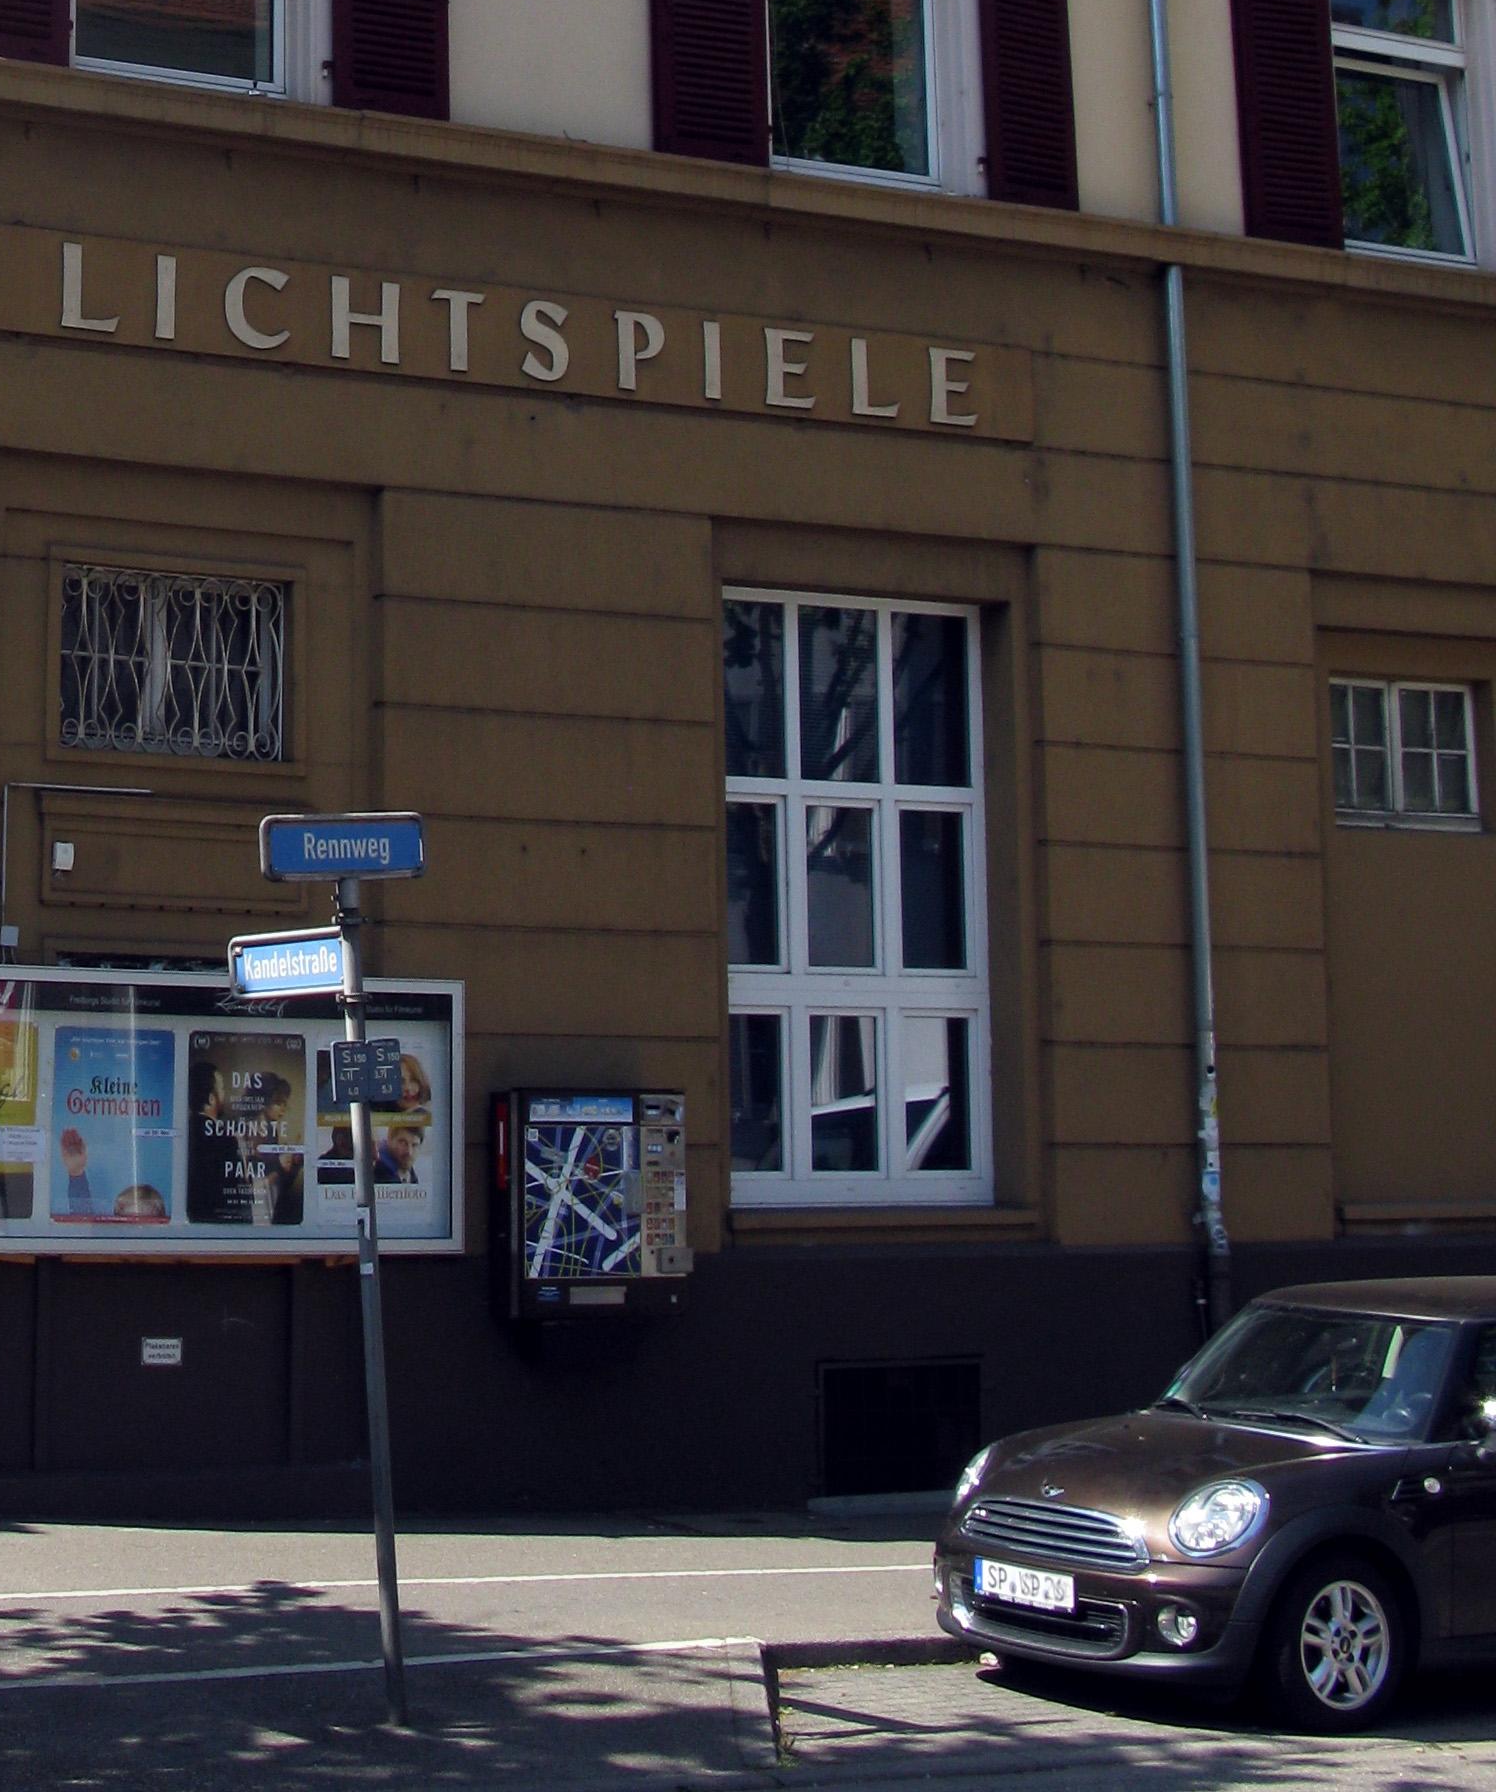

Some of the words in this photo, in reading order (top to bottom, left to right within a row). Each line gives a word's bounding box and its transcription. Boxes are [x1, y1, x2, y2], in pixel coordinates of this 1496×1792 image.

[59, 240, 980, 427] LICHTSPIELE
[303, 832, 391, 865] Rennweg
[244, 945, 338, 982] Kandelstraße
[231, 1071, 264, 1089] DAS
[204, 1116, 289, 1138] SCHÖNSTE
[224, 1160, 267, 1179] PAAR
[324, 1187, 346, 1200] Das
